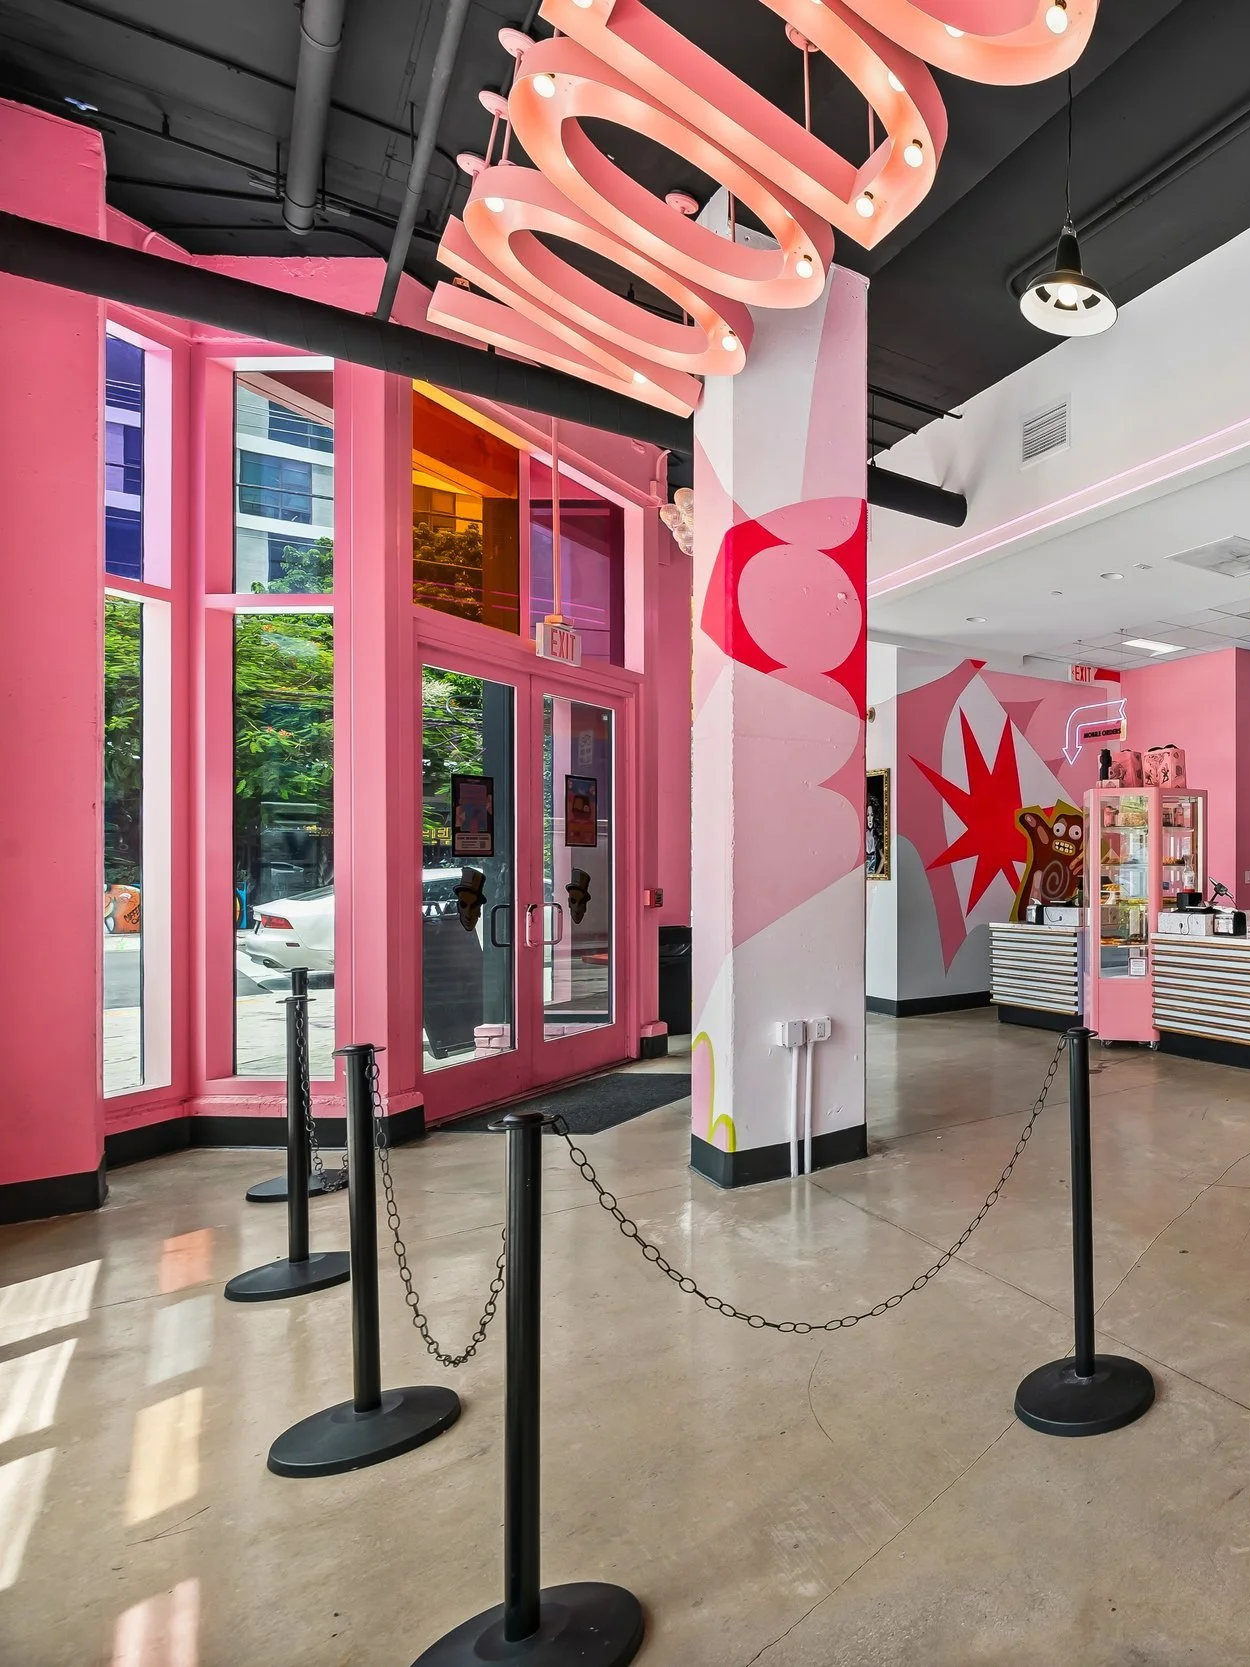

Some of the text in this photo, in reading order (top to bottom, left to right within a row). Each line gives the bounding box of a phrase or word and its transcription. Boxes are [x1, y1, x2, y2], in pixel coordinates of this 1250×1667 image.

[550, 629, 576, 662] EXIT
[1075, 665, 1091, 682] EXIT
[1084, 728, 1121, 738] MOBILE ORDERS
